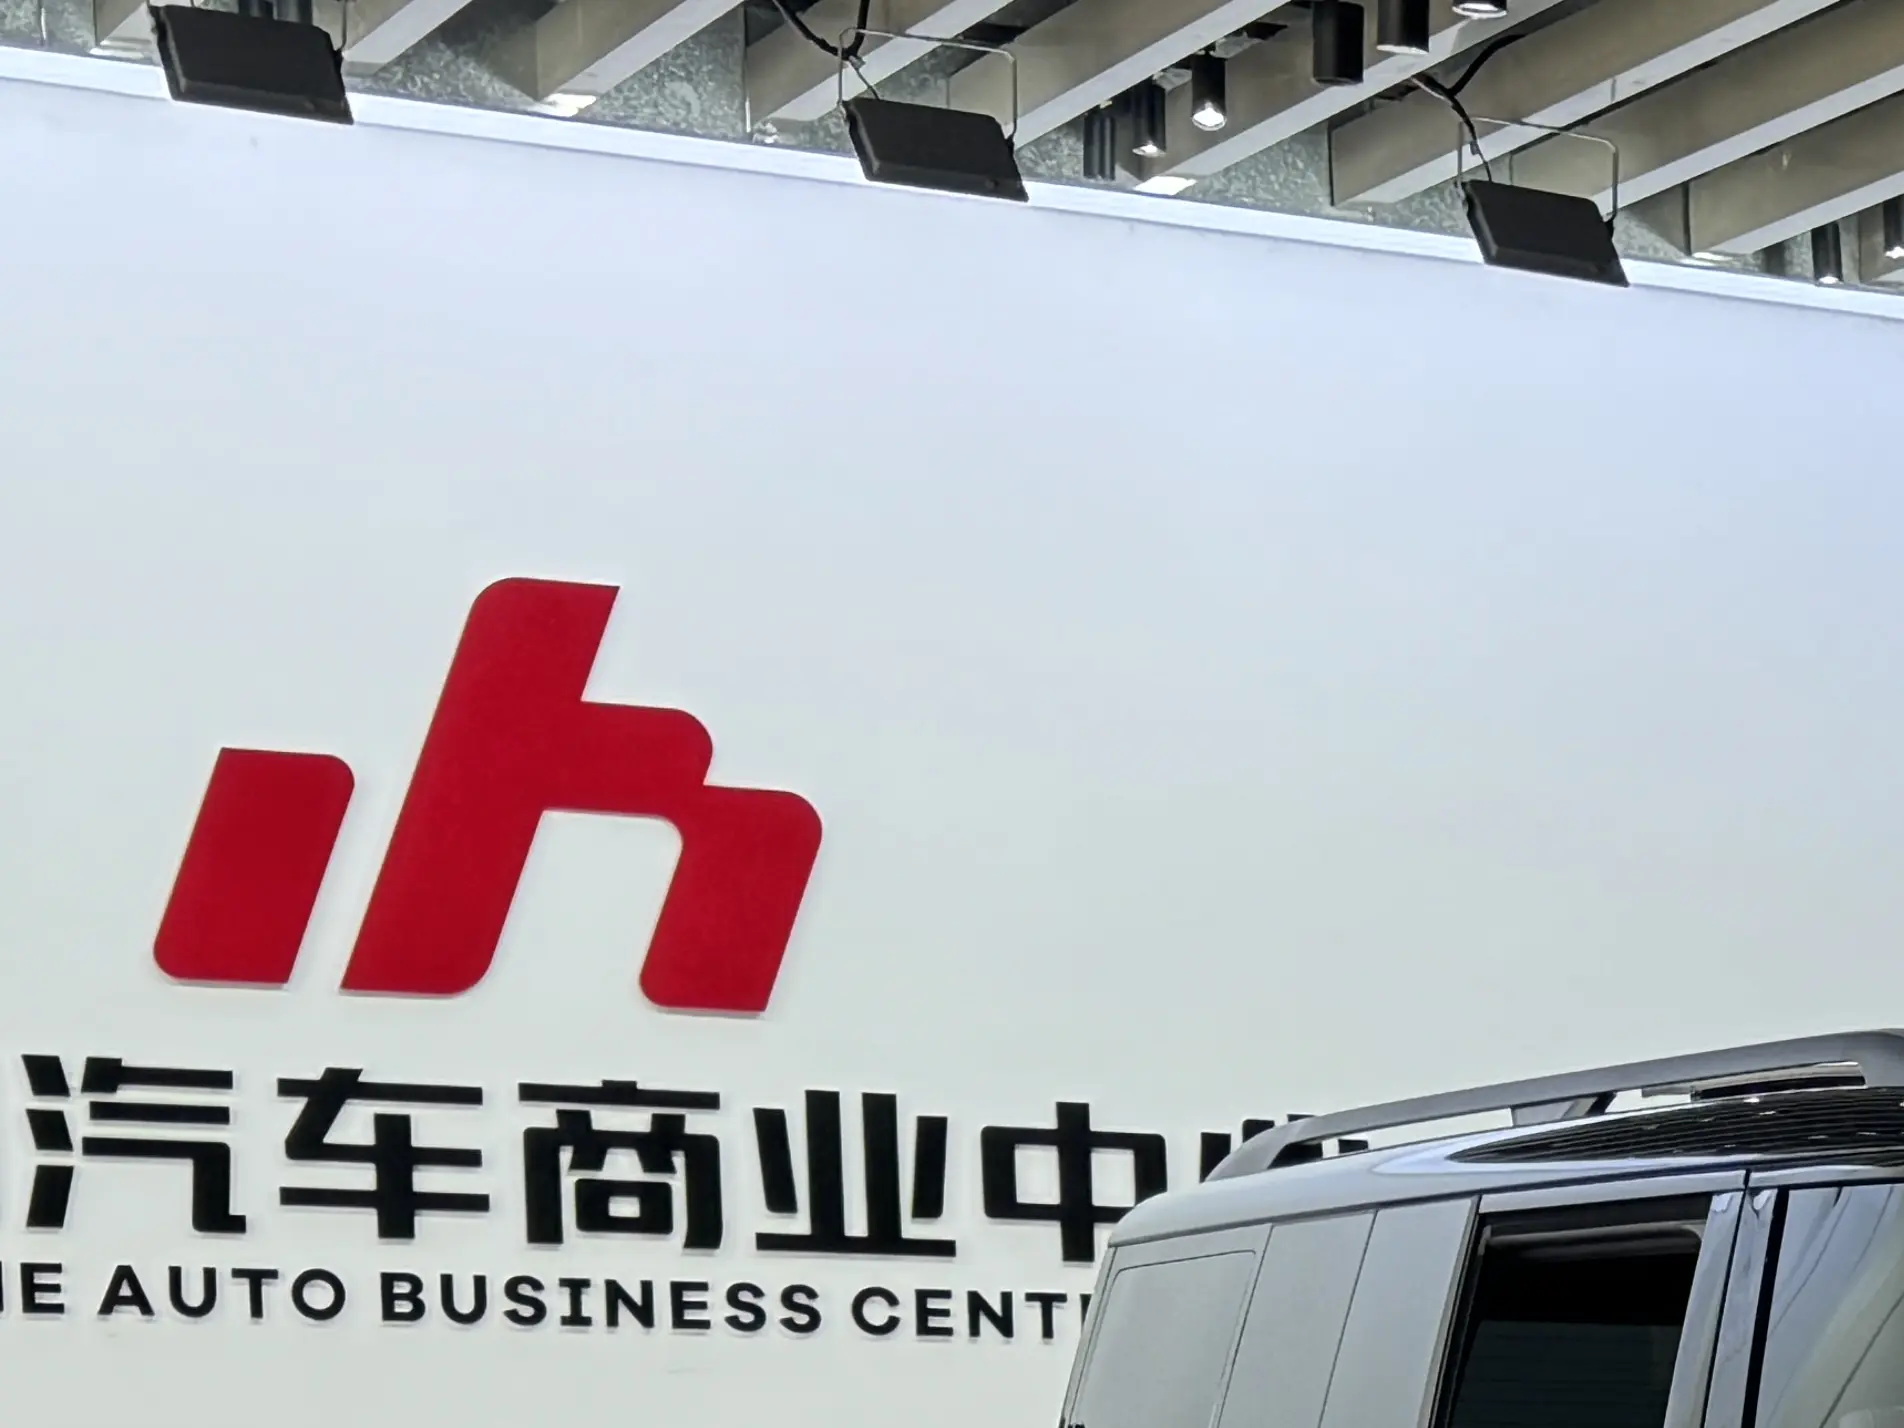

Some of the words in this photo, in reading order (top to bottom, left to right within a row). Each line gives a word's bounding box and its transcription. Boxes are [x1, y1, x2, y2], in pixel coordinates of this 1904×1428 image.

[0, 1260, 65, 1314] E
[98, 1264, 346, 1321] AUTO
[380, 1272, 822, 1334] BUSINESS
[851, 1286, 1092, 1339] CENT
